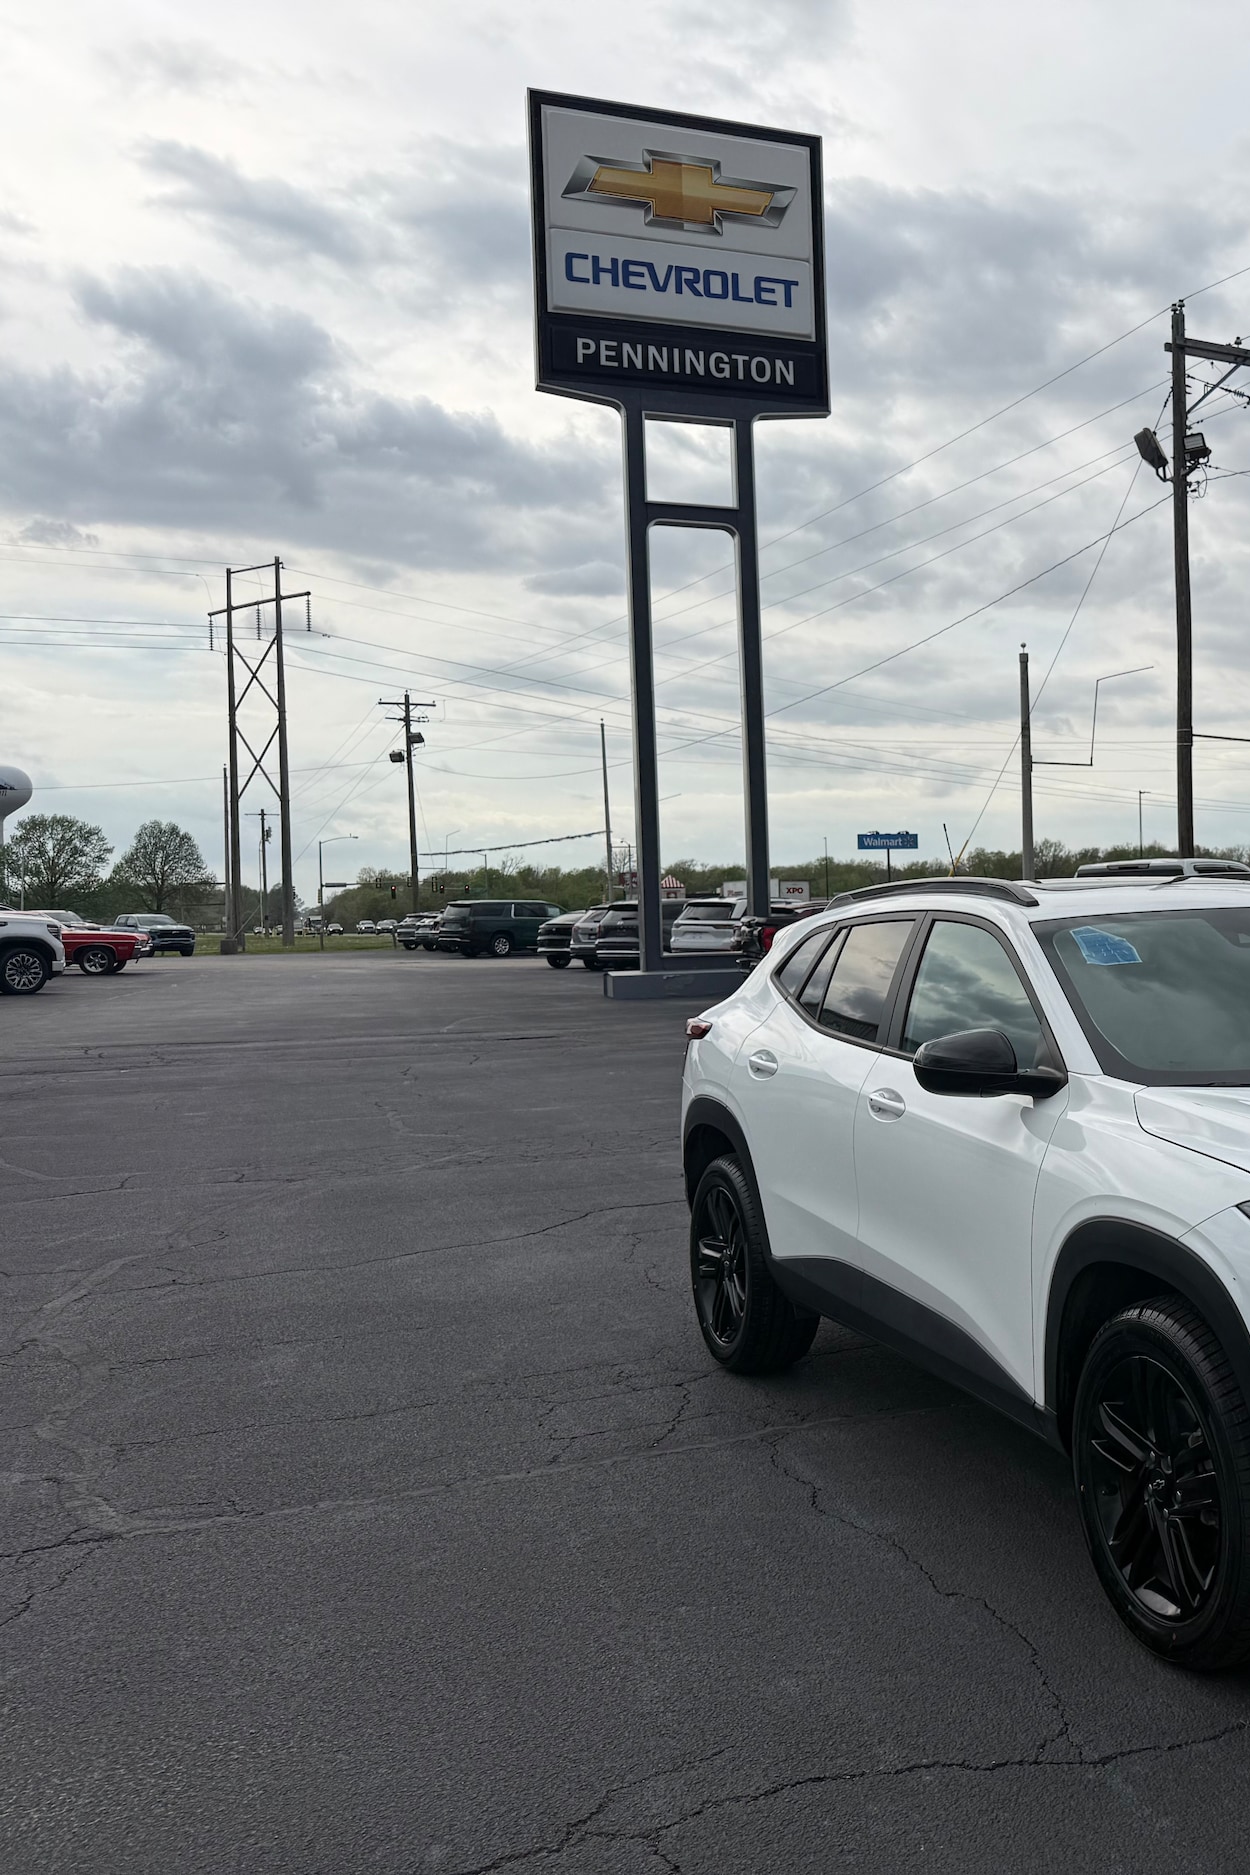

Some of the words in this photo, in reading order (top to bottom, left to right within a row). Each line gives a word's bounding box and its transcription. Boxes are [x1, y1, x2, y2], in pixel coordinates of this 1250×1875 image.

[564, 251, 799, 308] CHEVROLET
[576, 337, 795, 386] PENNINGTON
[863, 837, 902, 847] Walmart
